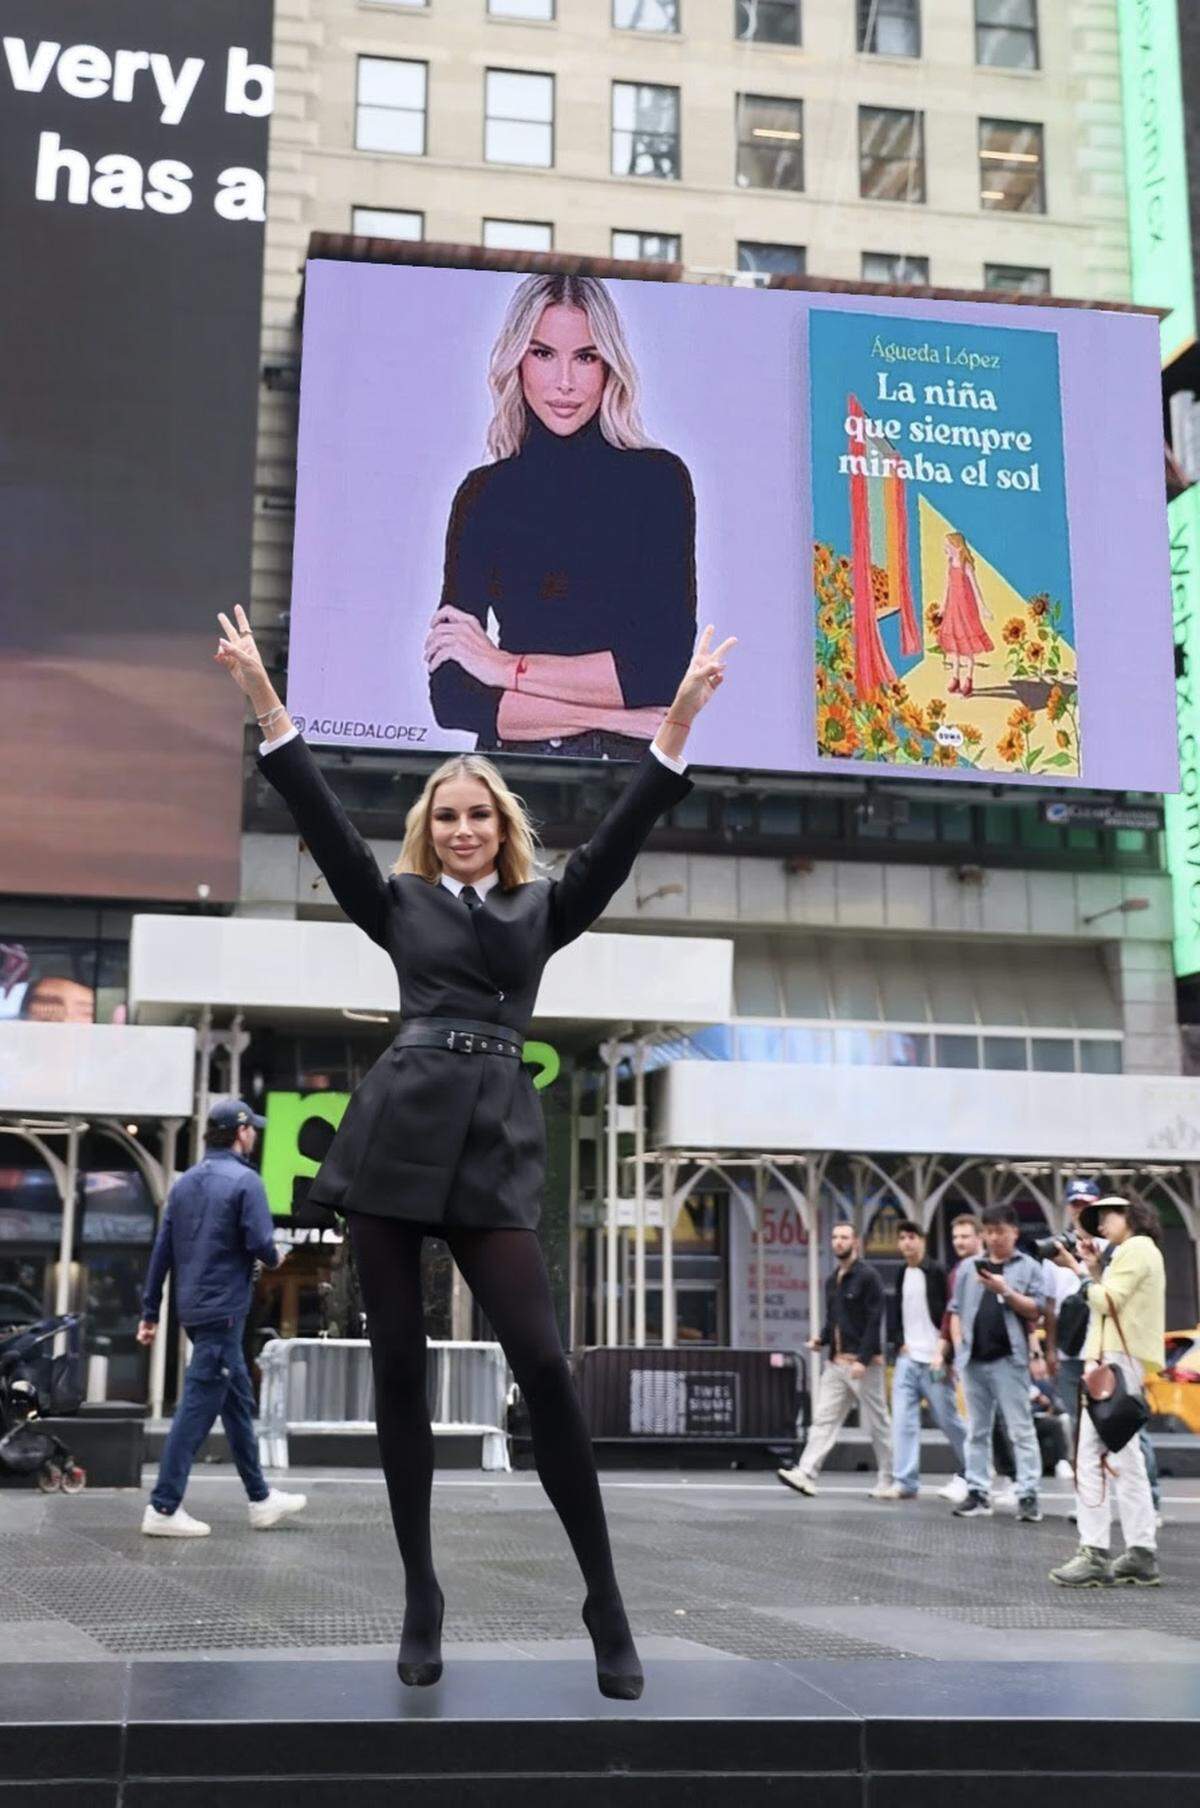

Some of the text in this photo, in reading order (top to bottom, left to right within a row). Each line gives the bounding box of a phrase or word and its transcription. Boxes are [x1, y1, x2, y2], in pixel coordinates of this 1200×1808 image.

[3, 36, 276, 126] very b
[35, 131, 266, 222] has a
[872, 335, 1000, 370] Águeda López
[877, 371, 998, 412] La niña
[844, 415, 1032, 455] que siempre
[838, 447, 1042, 492] miraba el sol
